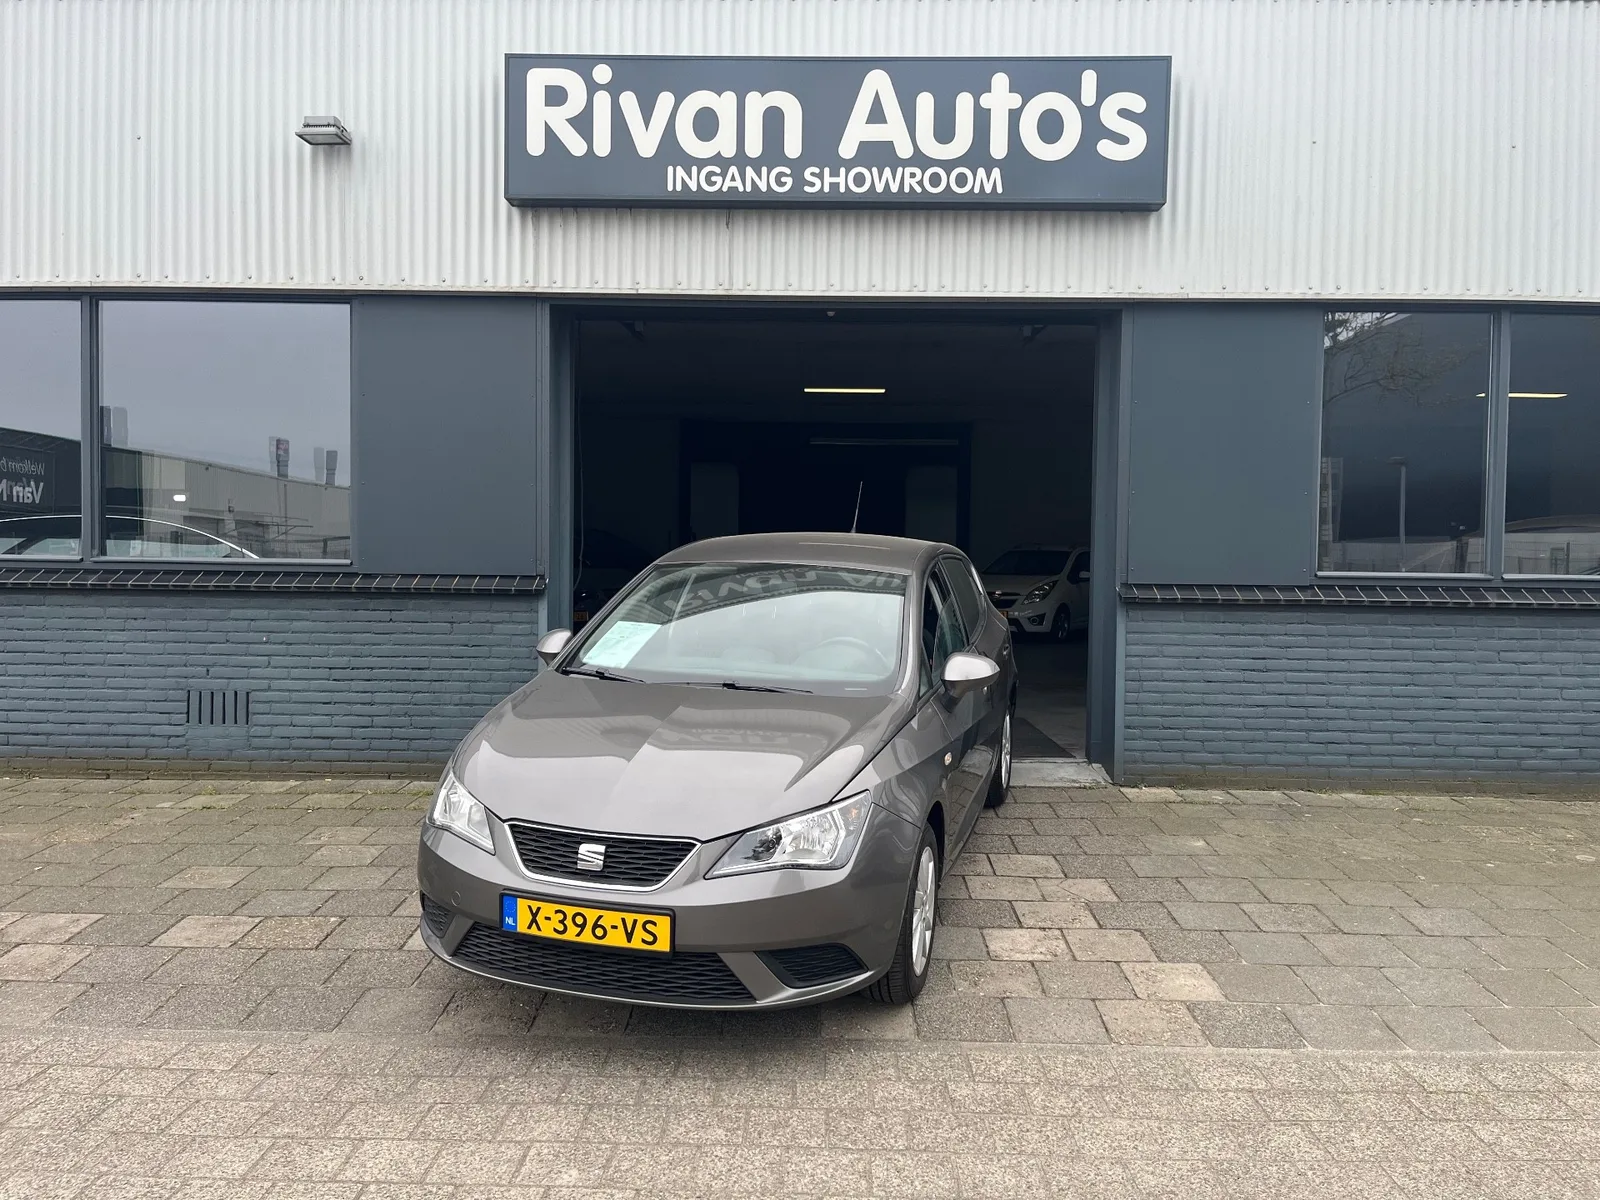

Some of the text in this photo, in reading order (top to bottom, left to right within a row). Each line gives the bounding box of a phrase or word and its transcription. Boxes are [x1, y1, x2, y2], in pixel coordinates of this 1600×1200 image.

[525, 63, 1148, 161] Rivan Auto's
[666, 165, 1004, 195] INGANG SHOWROOM
[505, 904, 659, 946] NL X-396-VS
